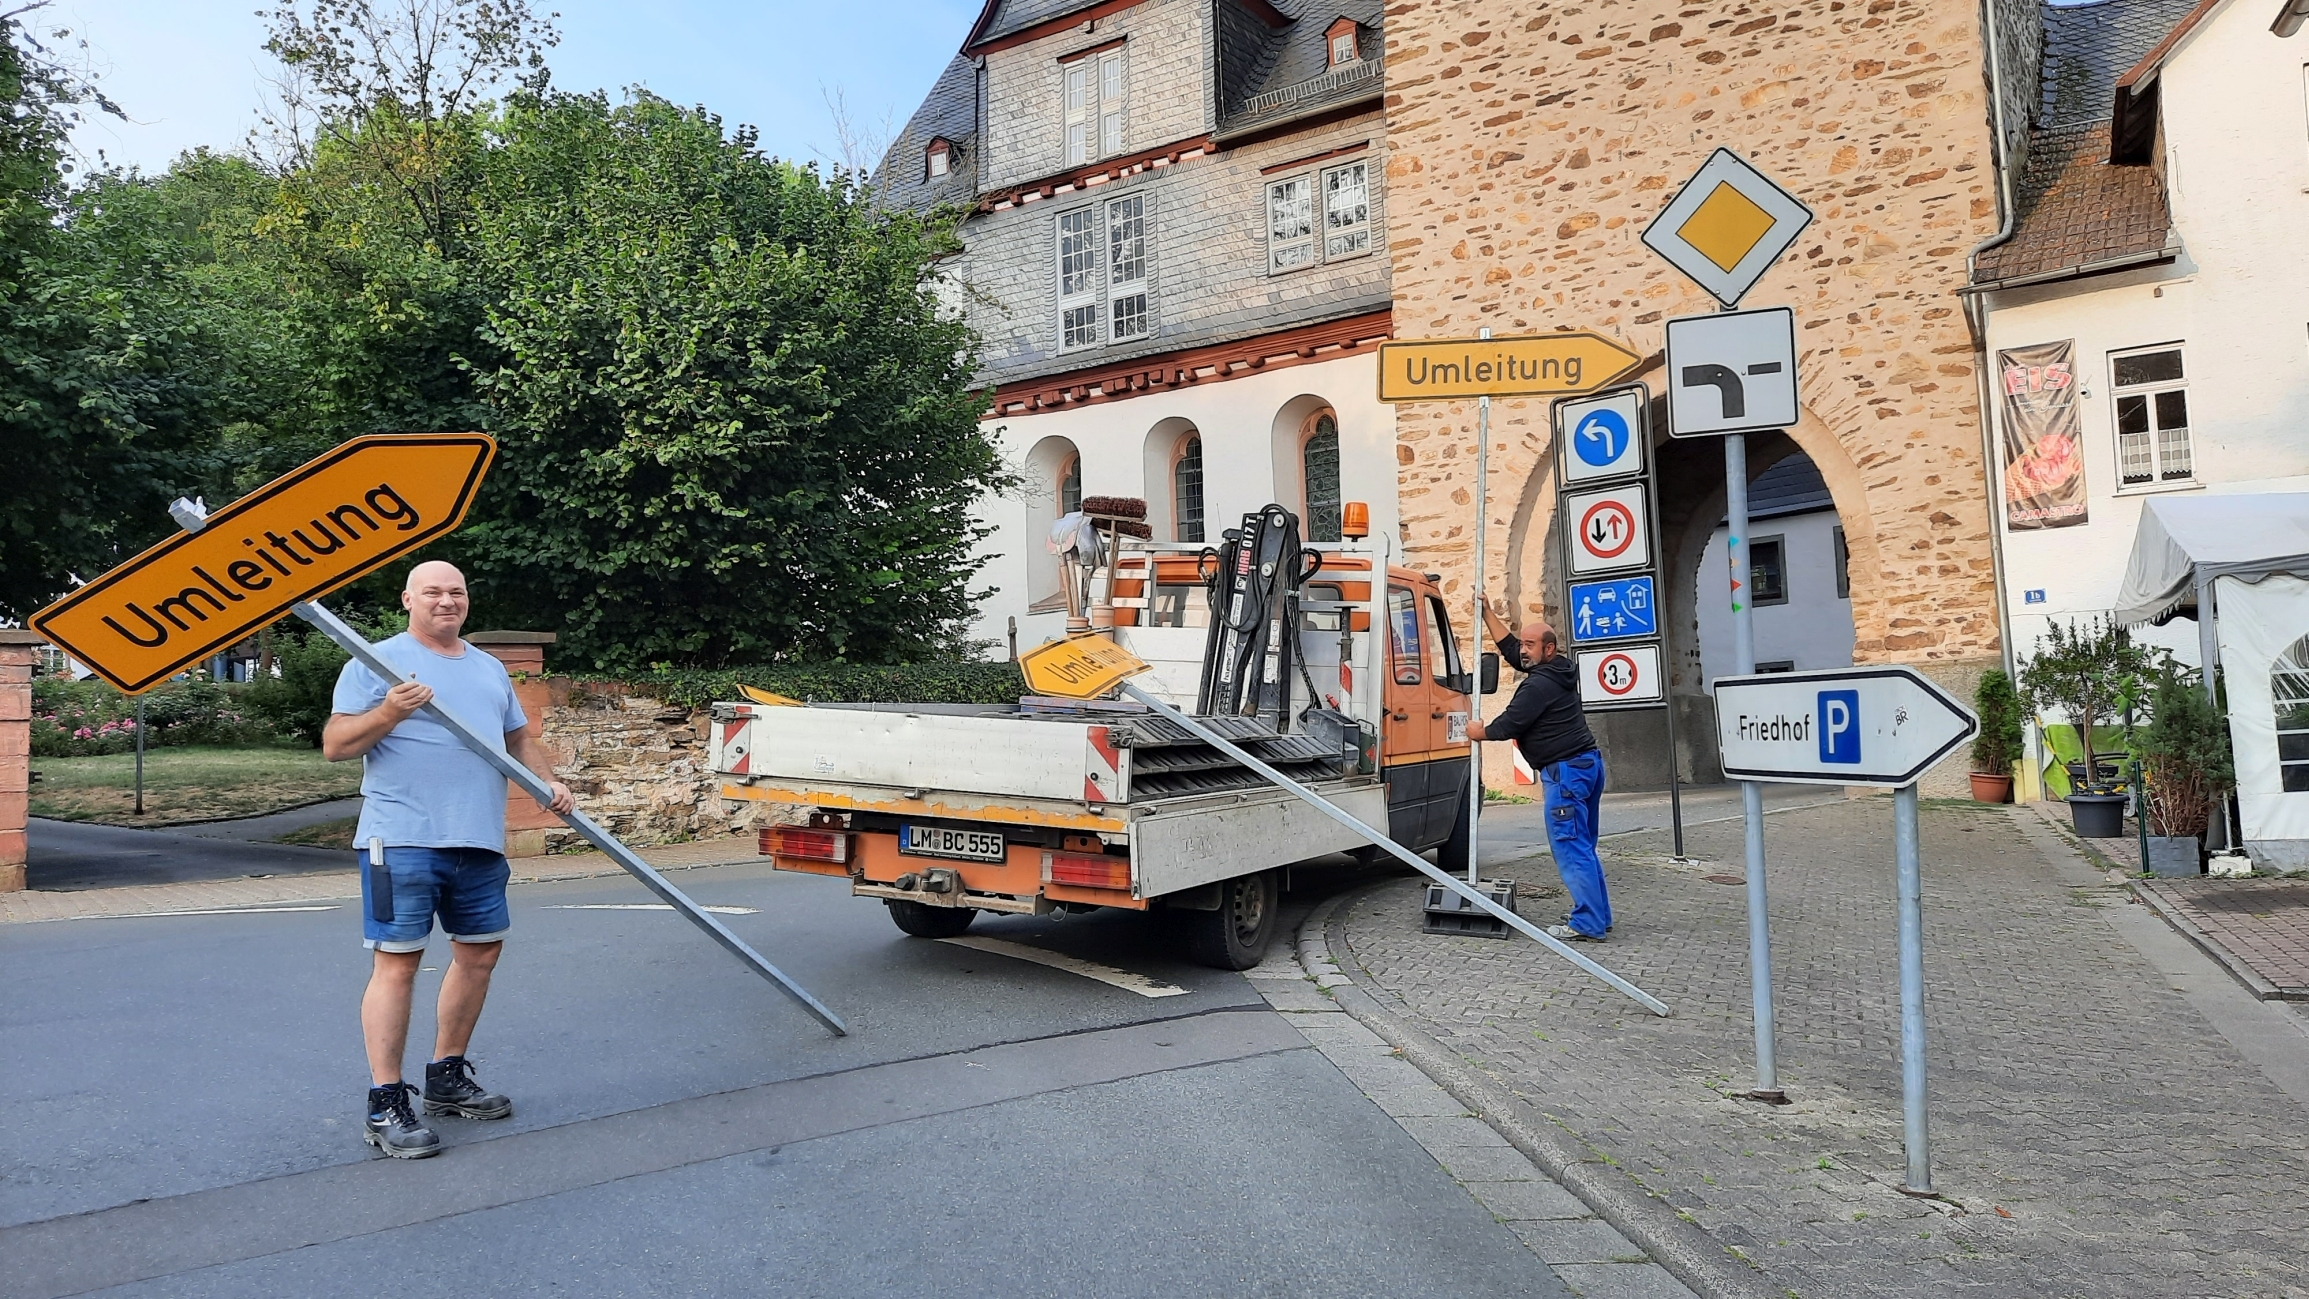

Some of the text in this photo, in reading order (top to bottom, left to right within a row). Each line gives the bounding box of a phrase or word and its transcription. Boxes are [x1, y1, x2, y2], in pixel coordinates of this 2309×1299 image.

[1406, 354, 1582, 386] Umleitung
[2004, 363, 2072, 396] EIS
[2010, 504, 2085, 522] CAMASTRO
[100, 482, 420, 648] Umleitung
[1237, 549, 1251, 575] HIAB
[1608, 664, 1618, 685] 3
[1739, 699, 1850, 754] Friedhof P
[910, 828, 1001, 855] LM BC 555
